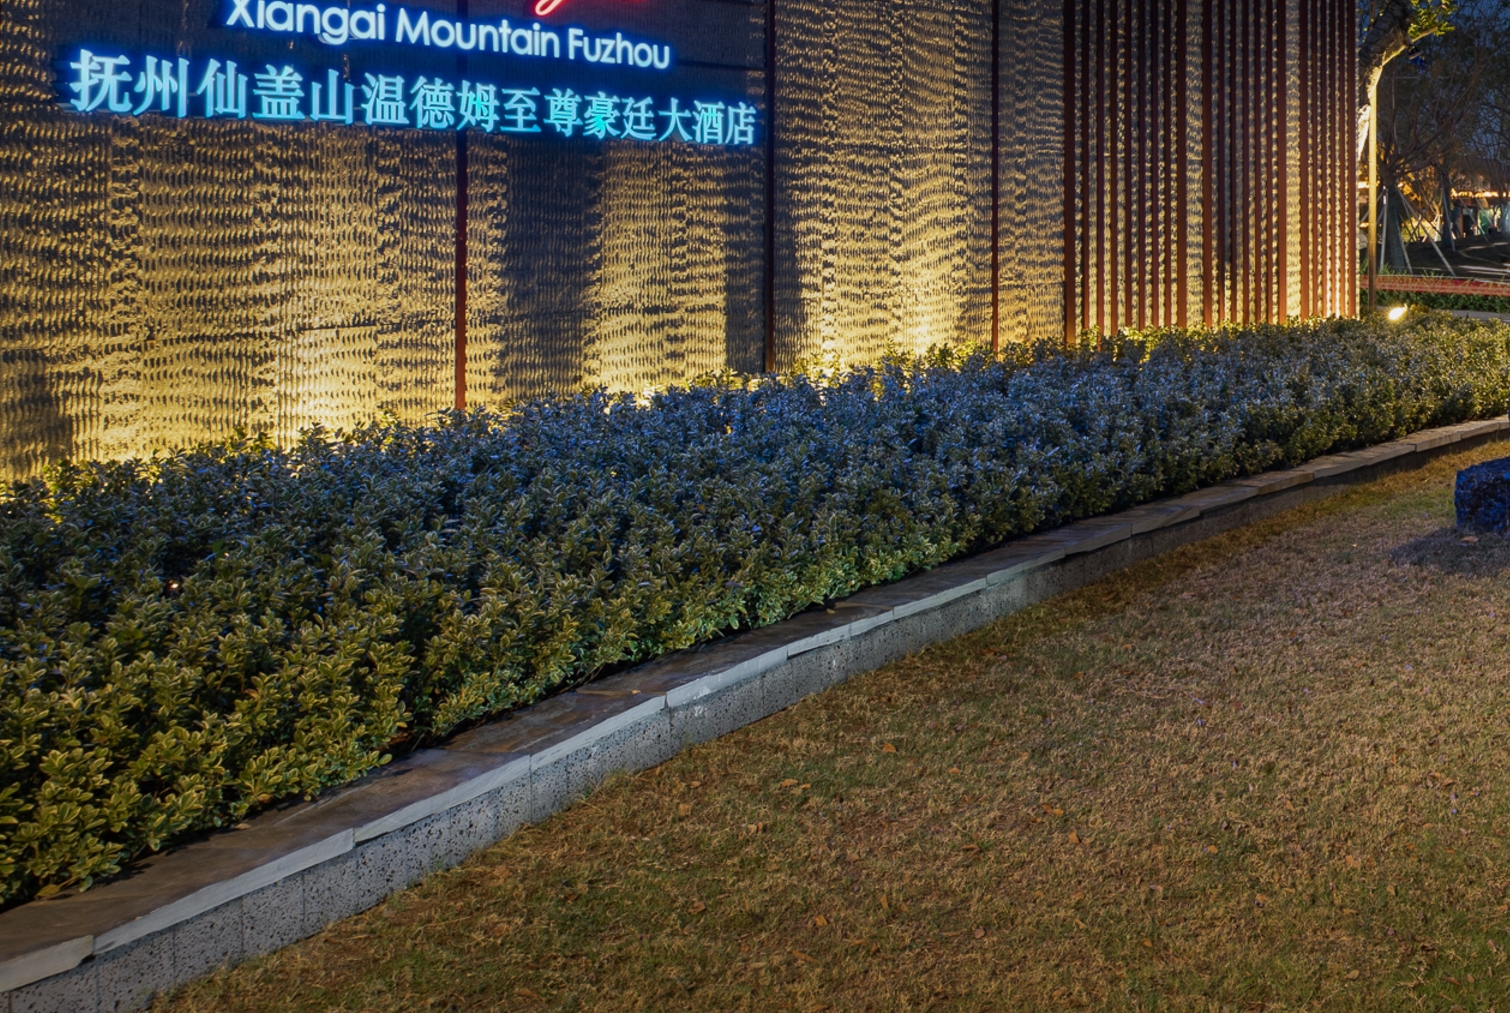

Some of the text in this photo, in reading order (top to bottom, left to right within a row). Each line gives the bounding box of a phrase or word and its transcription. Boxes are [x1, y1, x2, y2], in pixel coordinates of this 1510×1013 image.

[395, 10, 559, 60] Mountain
[569, 28, 670, 69] Fuzhou
[69, 49, 756, 144] 抚州仙盖山温德姆至尊豪廷大酒店
